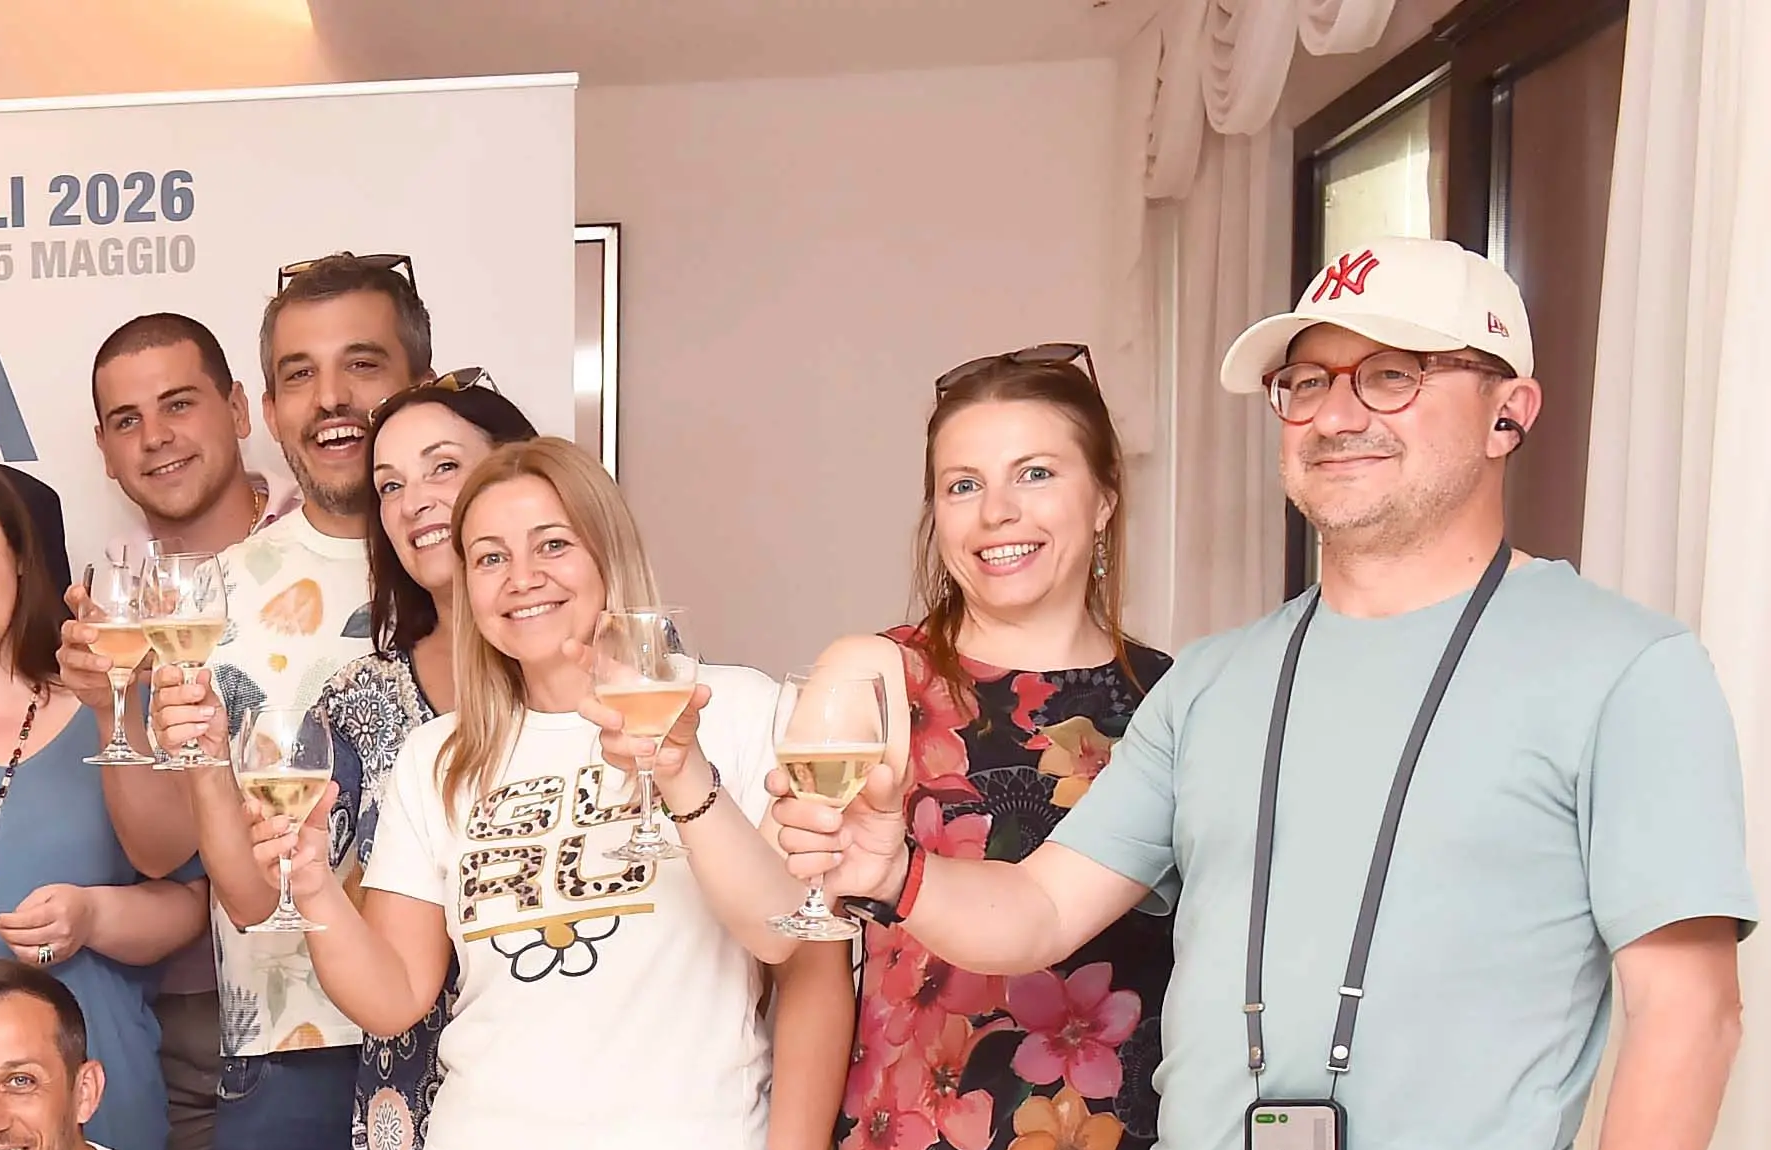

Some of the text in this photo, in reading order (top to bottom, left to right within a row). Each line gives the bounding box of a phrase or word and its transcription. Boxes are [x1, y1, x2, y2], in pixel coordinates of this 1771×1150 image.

[48, 170, 194, 227] 2026
[31, 234, 196, 279] MAGGIO
[458, 834, 658, 925] RU
